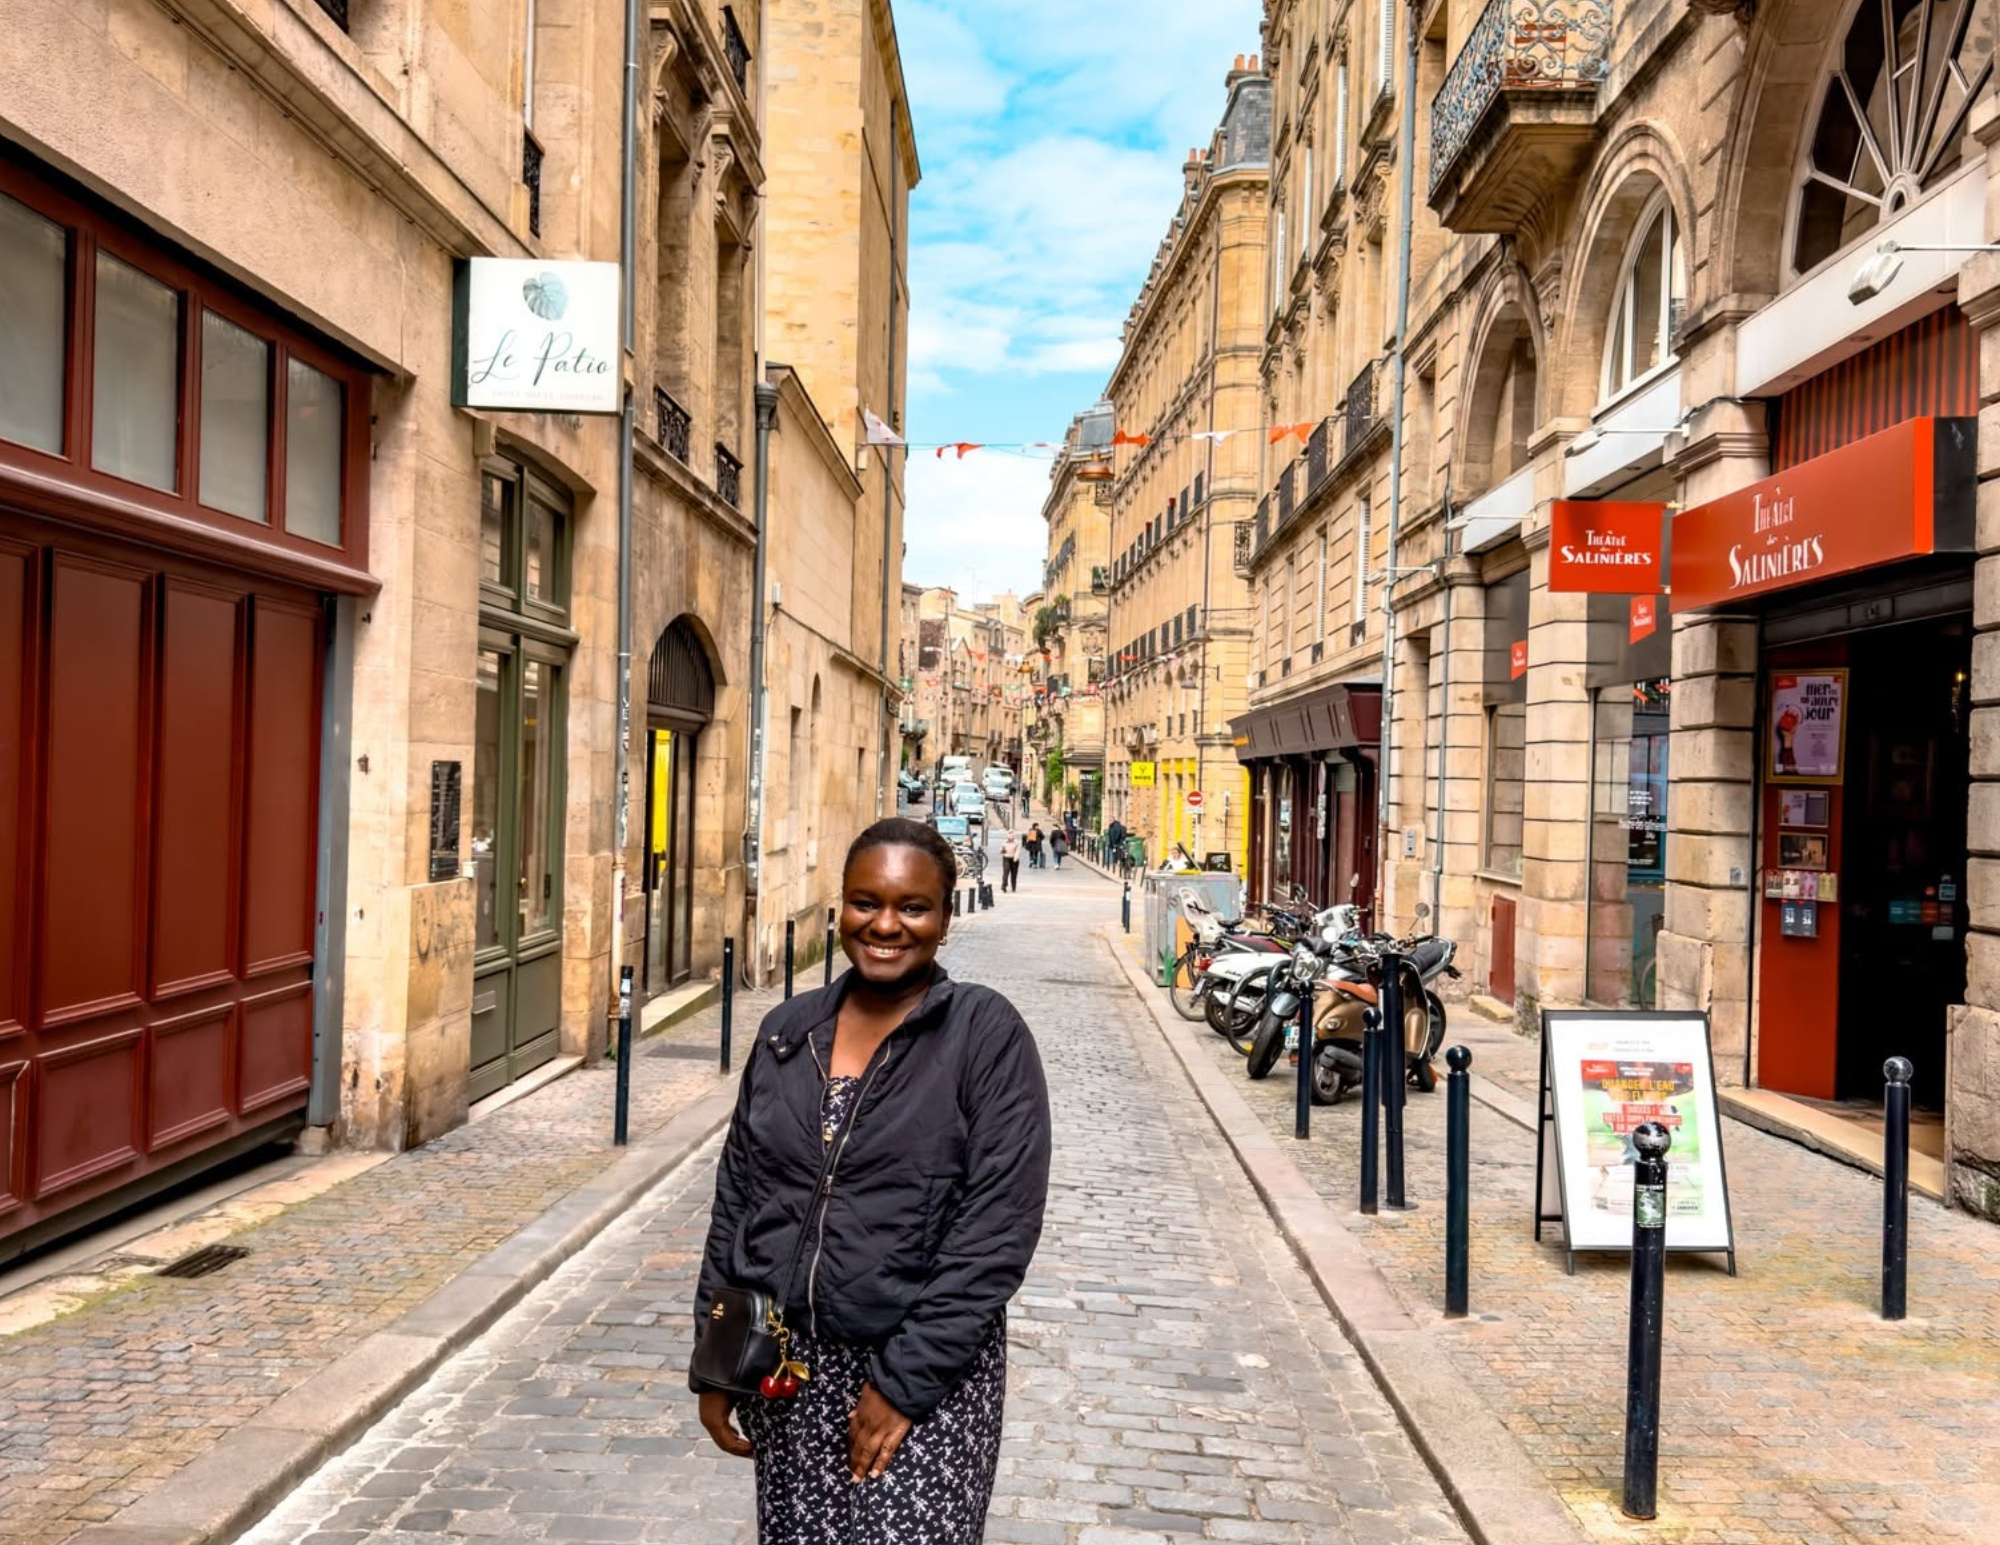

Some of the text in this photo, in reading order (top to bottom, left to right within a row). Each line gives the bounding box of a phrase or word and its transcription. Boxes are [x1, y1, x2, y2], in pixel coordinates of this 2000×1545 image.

[470, 329, 611, 387] Le Patio
[1561, 545, 1652, 565] SALINIÈRES
